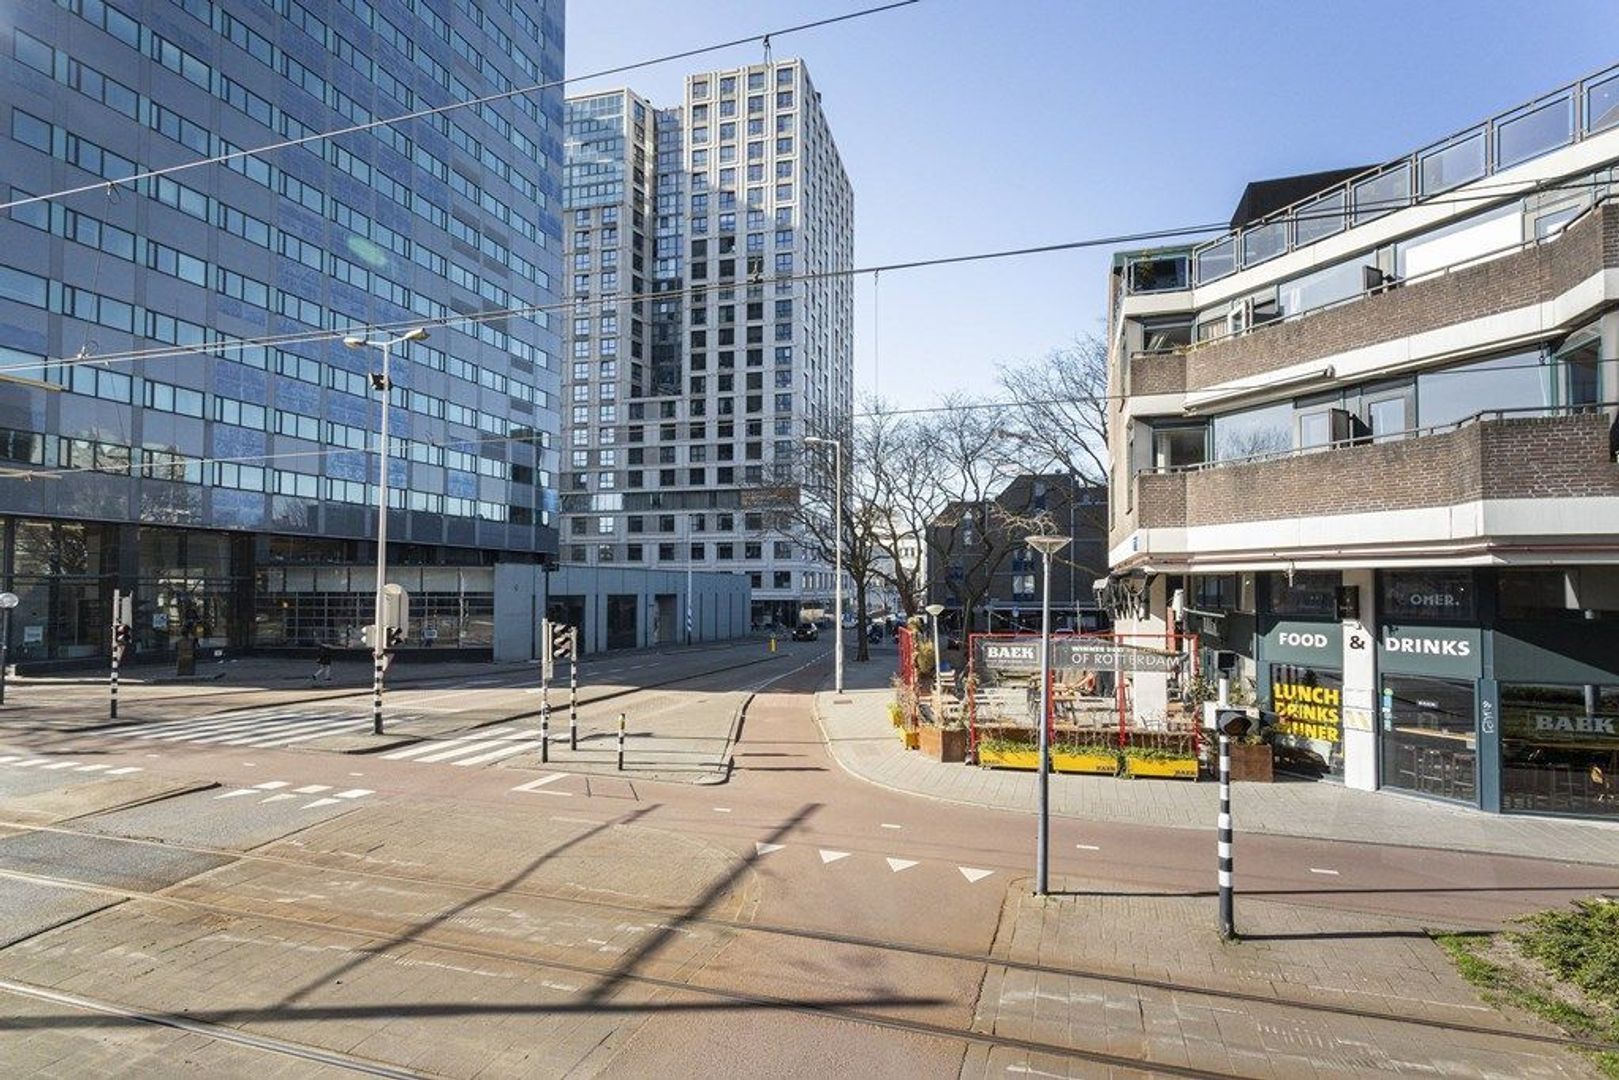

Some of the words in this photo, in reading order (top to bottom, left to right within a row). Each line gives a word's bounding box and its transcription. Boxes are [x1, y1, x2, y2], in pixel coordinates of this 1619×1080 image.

[1410, 594, 1460, 606] OMER.
[987, 646, 1034, 659] BAEK
[1279, 632, 1328, 648] FOOD
[1350, 635, 1365, 650] &
[1385, 637, 1471, 656] DRINKS
[1072, 653, 1089, 664] OF
[1095, 653, 1180, 668] ROTTERDAM
[1274, 683, 1340, 705] LUNCH
[1275, 702, 1340, 724] DRINKS
[1275, 721, 1340, 742] NNER
[1536, 715, 1616, 734] BAEK
